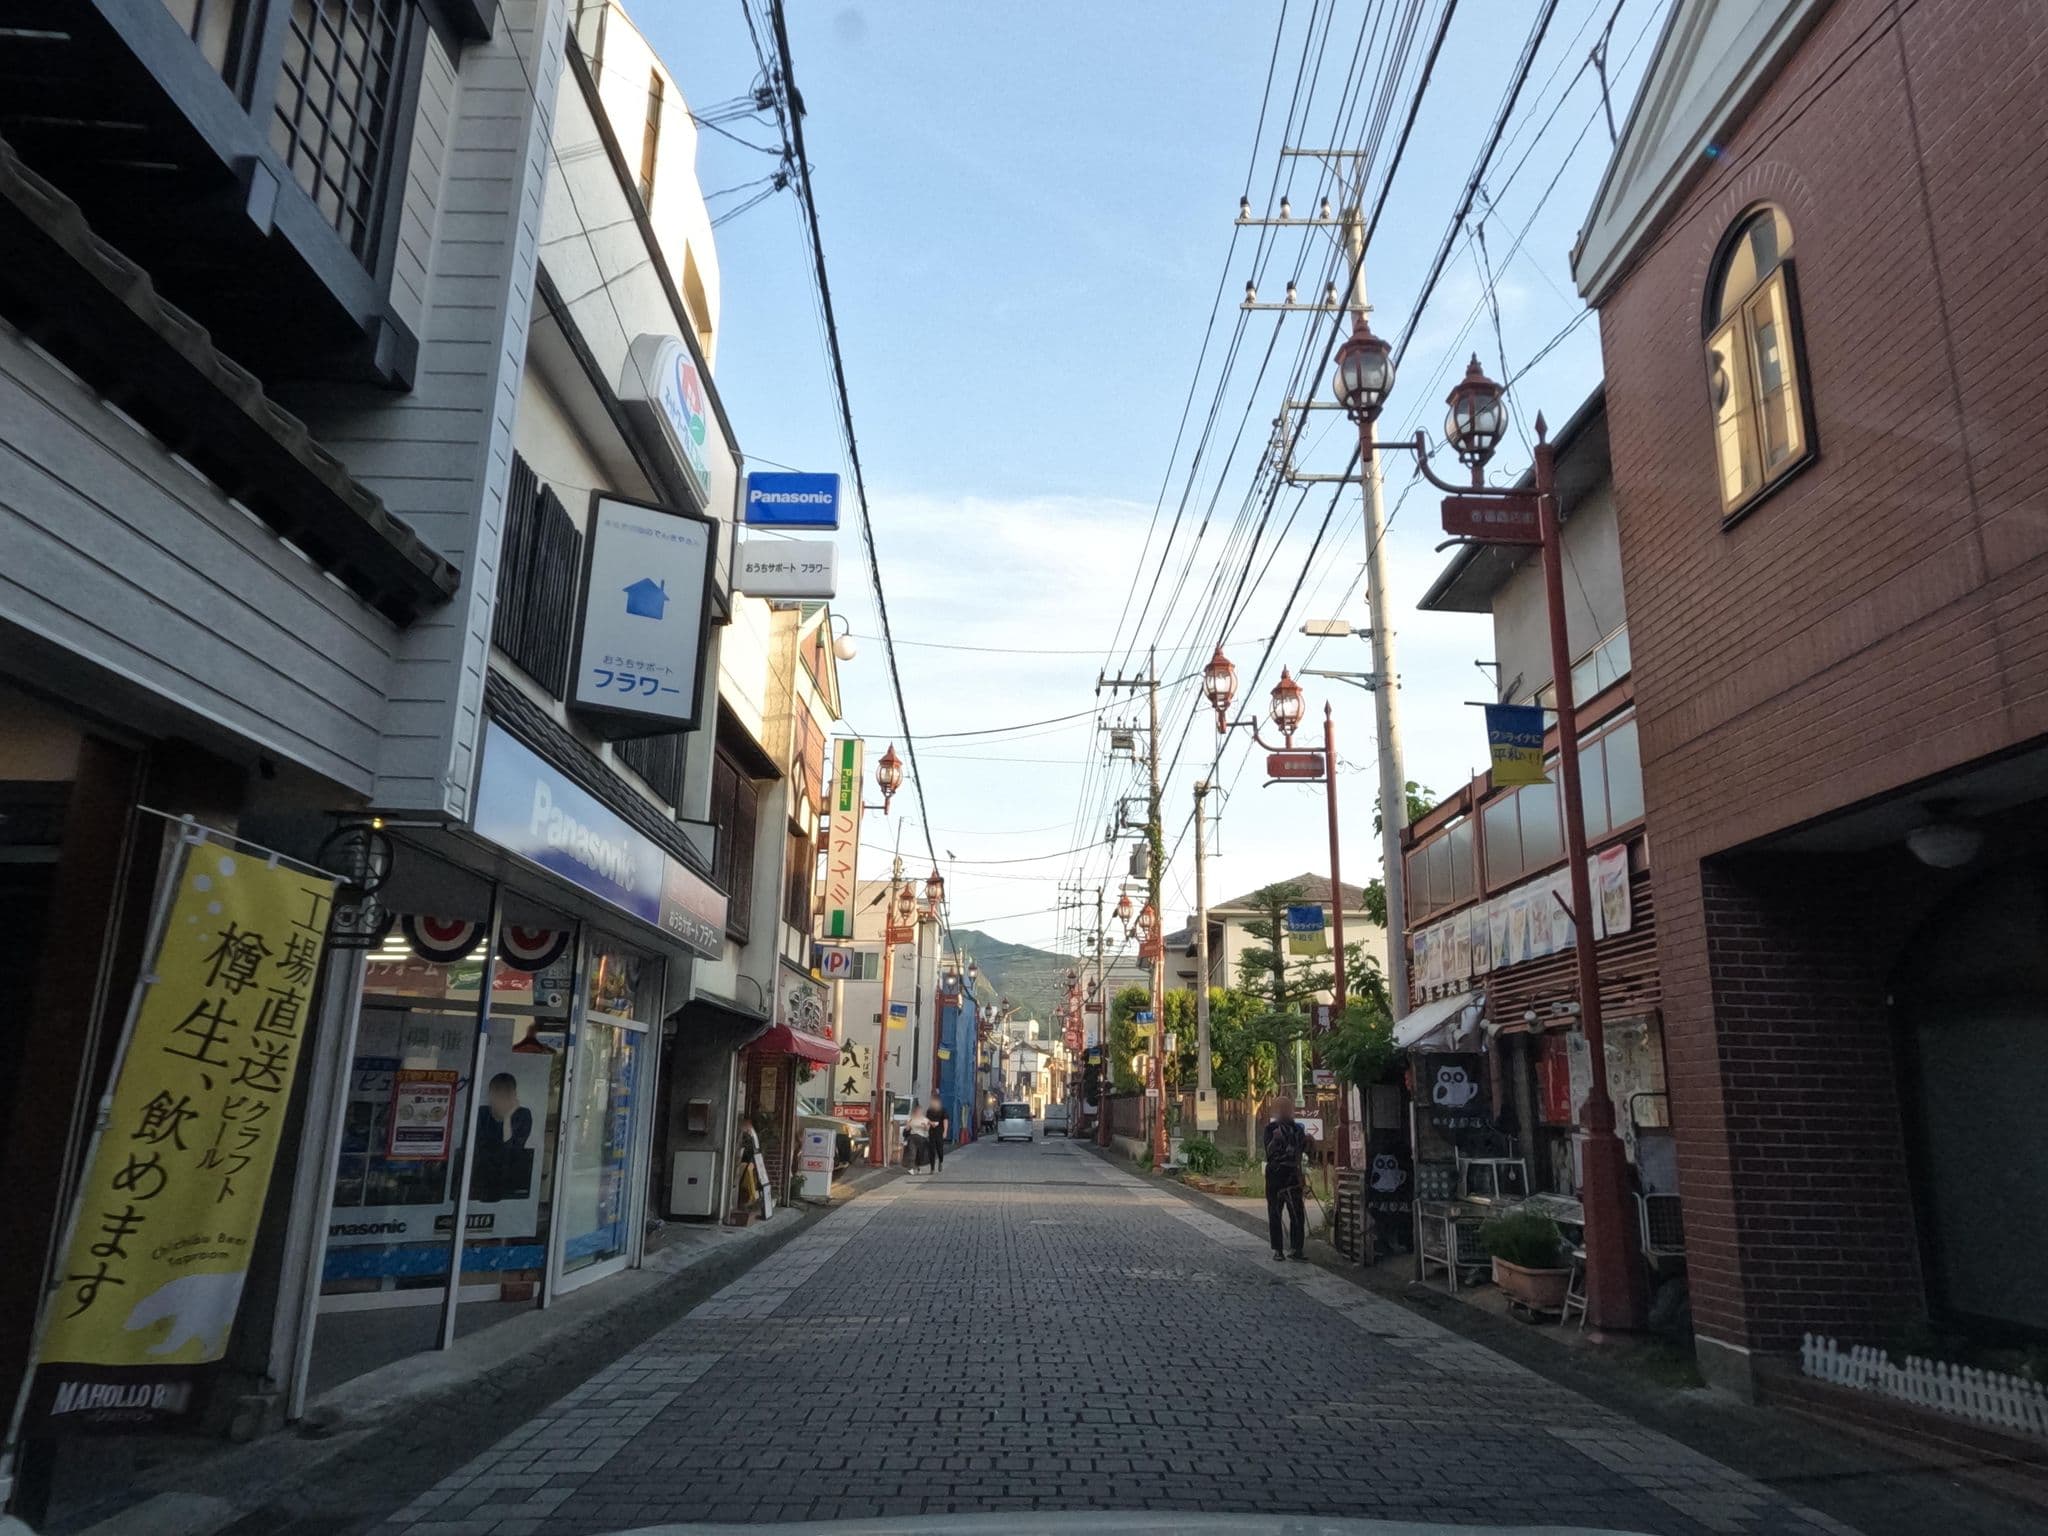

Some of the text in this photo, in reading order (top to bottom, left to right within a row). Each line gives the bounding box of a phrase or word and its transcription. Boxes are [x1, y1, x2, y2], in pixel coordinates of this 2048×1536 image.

[750, 489, 833, 505] Panasonic
[745, 561, 830, 575] おうちサポート フラワー
[593, 668, 680, 696] フラワー
[602, 654, 674, 675] おうちサポート
[841, 768, 853, 806] Parlor
[530, 778, 635, 893] Panasonic
[668, 912, 718, 948] おうちサポート フラワー
[830, 952, 844, 973] P
[229, 887, 333, 1094] 工場直送
[64, 919, 273, 1321] 樽生、飲めます
[1294, 1110, 1319, 1118] ーキング
[195, 1096, 243, 1171] ビール
[215, 1099, 270, 1205] クラフト
[50, 1381, 149, 1416] MAHOLLO
